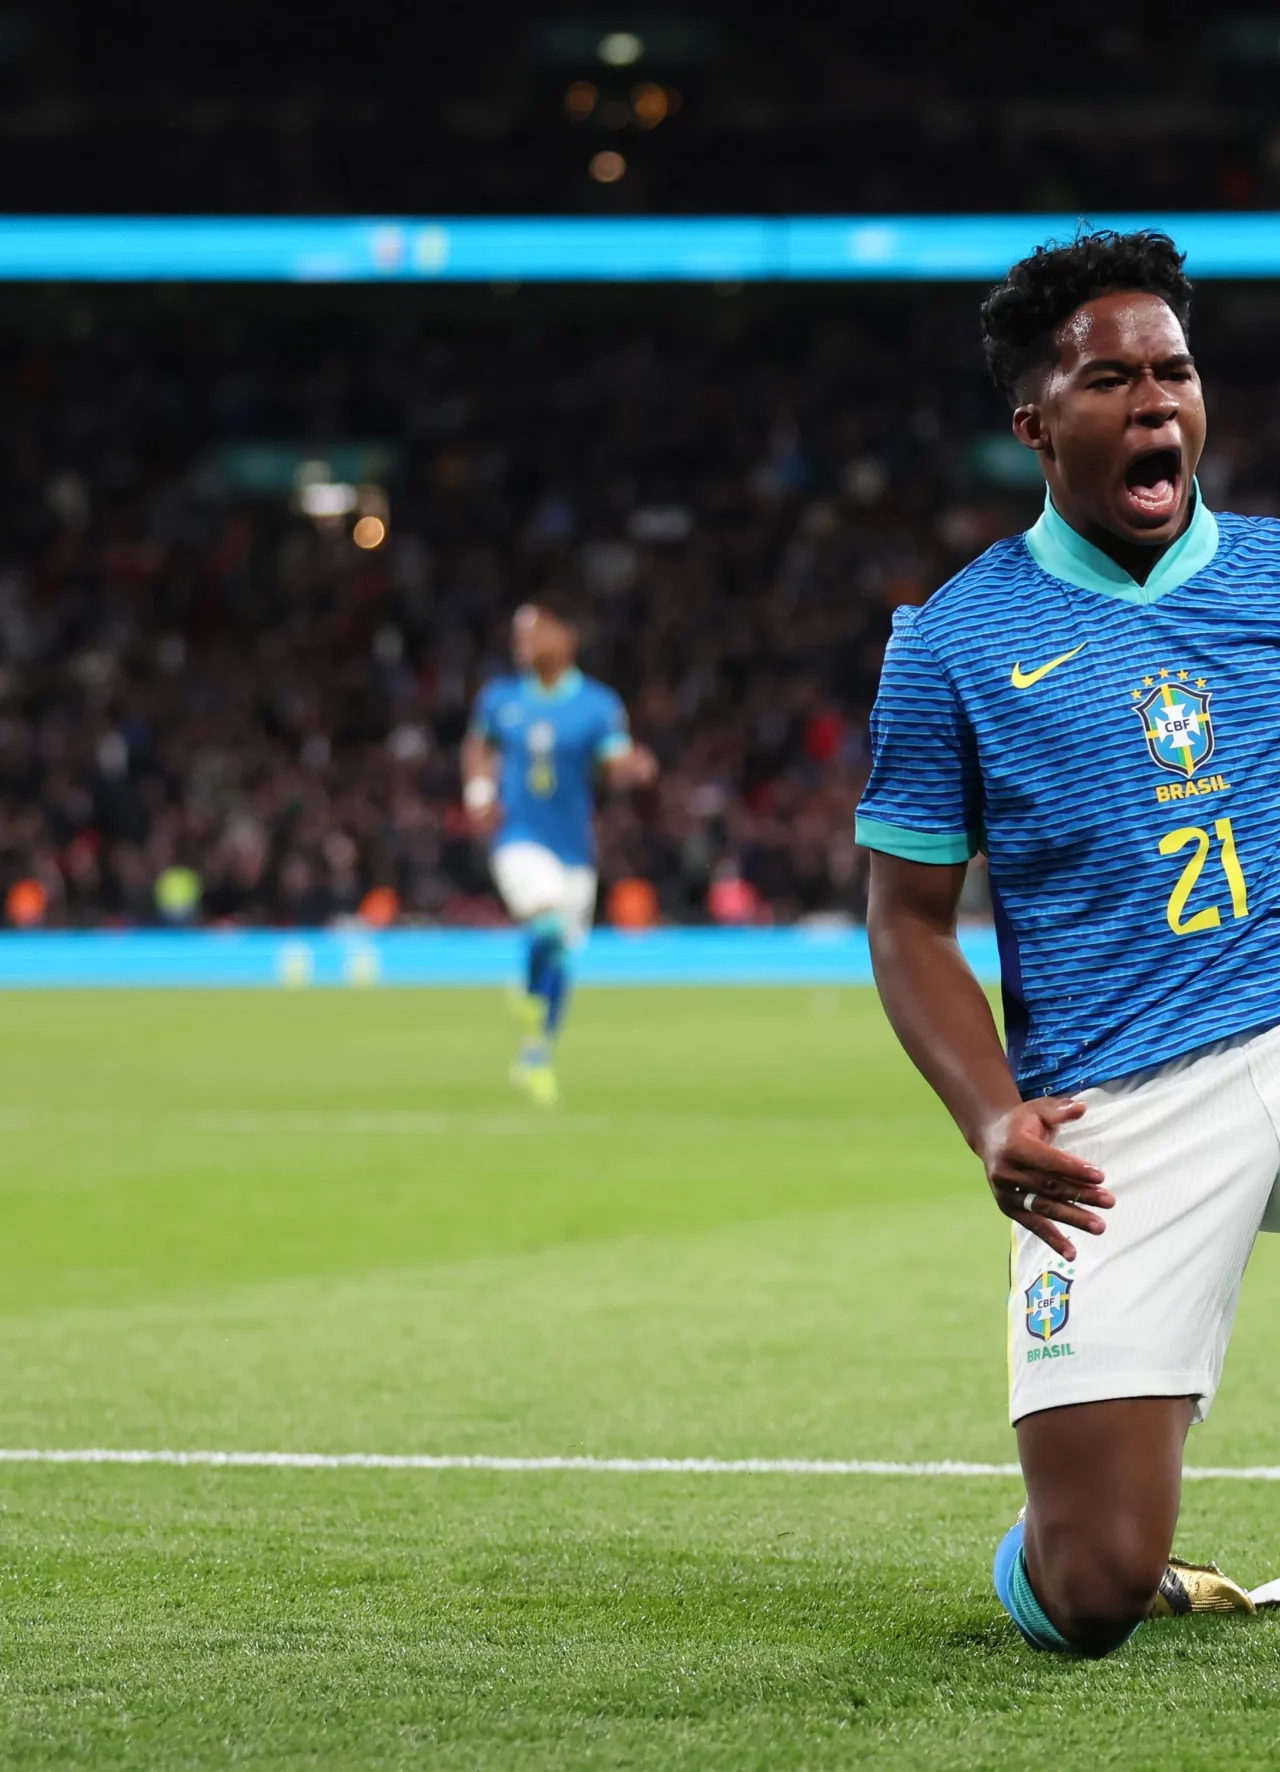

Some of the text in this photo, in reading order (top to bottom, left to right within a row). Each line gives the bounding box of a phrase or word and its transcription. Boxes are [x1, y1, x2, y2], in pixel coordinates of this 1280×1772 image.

[1165, 718, 1190, 733] CBF
[1155, 775, 1231, 803] BRASIL
[1158, 817, 1249, 936] 21
[1037, 1298, 1055, 1309] CBF
[1027, 1343, 1075, 1363] BRASIL
